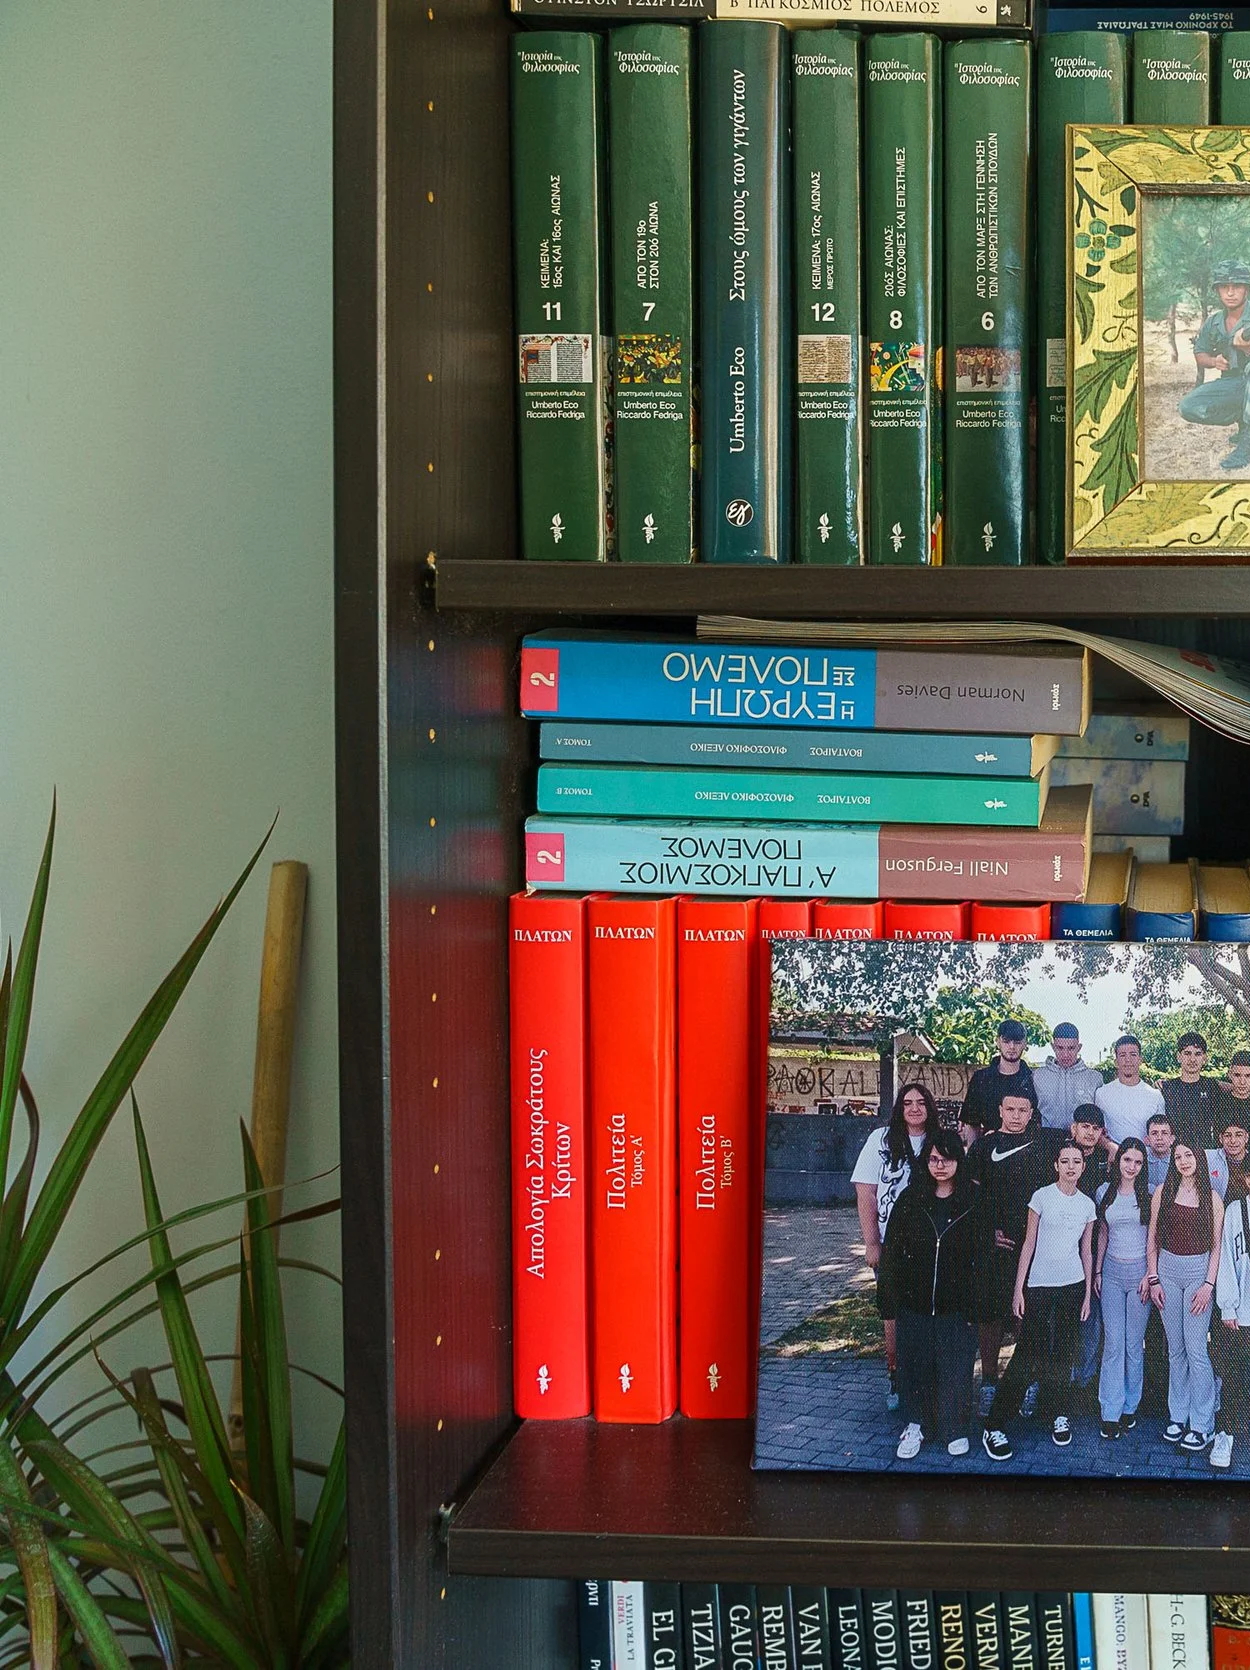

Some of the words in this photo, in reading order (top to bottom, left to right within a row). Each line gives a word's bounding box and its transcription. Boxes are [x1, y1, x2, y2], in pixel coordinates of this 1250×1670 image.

[860, 0, 940, 14] ΠΟΛΕΜΟΣ
[1149, 21, 1173, 29] ΜΙΑΣ
[522, 61, 580, 75] Φιλοσοφίας
[1147, 69, 1207, 83] Φιλοσοφίας
[959, 73, 1020, 87] Φιλοσοφίας
[728, 69, 750, 150] γιγάντων
[733, 153, 746, 185] των
[975, 140, 985, 190] ΓΕΝΝΗΣΗ
[988, 132, 998, 183] ΣΠΟΥΔΩΝ
[895, 147, 907, 208] ΕΠΙΣΤΗΜΕΣ
[550, 175, 560, 216] ΑΙΩΝΑΣ
[811, 172, 821, 212] ΑΙΩΝΑΣ
[976, 193, 986, 215] ΣΤΗ
[729, 189, 749, 245] ώμους
[896, 210, 906, 228] ΚΑΙ
[976, 217, 986, 248] ΜΑΡΞ
[988, 186, 999, 273] ΑΝΘΡΩΠΙΣΤΙΚΩΝ
[553, 244, 562, 263] ΚΑΙ
[636, 242, 646, 264] ΤΟΝ
[826, 237, 834, 263] ΠΡΩΤΟ
[540, 238, 550, 289] ΚΕΙΜΕΝΑ:
[811, 240, 822, 290] ΚΕΙΜΕΝΑ:
[896, 231, 907, 296] ΦΙΛΟΣΟΦΙΕΣ
[976, 251, 986, 273] ΤΟΝ
[636, 267, 646, 289] ΑΠΟ
[729, 250, 750, 301] Στους
[976, 276, 986, 299] ΑΠΟ
[988, 278, 999, 299] ΤΩΝ
[542, 302, 562, 321] 11
[642, 302, 656, 322] 7
[811, 302, 835, 322] 12
[889, 310, 903, 330] 8
[981, 311, 995, 331] 6
[730, 346, 745, 377] Eco
[616, 410, 651, 420] Riccardo
[653, 410, 683, 420] Fedriga
[623, 401, 657, 410] Umberto
[659, 402, 676, 410] Eco
[729, 381, 745, 453] Umberto
[662, 651, 829, 687] ΠΟΛΕΜΟ
[897, 683, 950, 700] Davies
[957, 687, 1025, 703] Norman
[690, 687, 836, 720] ΕΥΡΩΠΗ
[563, 739, 593, 747] ΤΟΜΟΣ
[690, 742, 725, 753] ΛΕΞΙΚΟ
[726, 744, 788, 755] ΦΙΛΟΣΟΦΙΚΟ
[809, 747, 863, 758] ΒΟΛΤΑΙΡΟΣ
[660, 837, 801, 860] ΠΟΛΕΜΟΣ
[619, 862, 801, 888] ΠΑΓΚΟΣΜΙΟΣ
[885, 856, 964, 876] Ferguson
[969, 860, 1009, 876] Niall
[514, 929, 573, 942] ΠΛΑΤΩΝ
[595, 926, 655, 939] ΠΛΑΤΩΝ
[684, 929, 746, 942] ΠΛΑΤΩΝ
[525, 1047, 549, 1169] Σωκράτους
[551, 1122, 577, 1199] Κρίτων
[606, 1113, 627, 1210] Πολιτεία
[630, 1149, 646, 1188] Τόμος
[695, 1114, 716, 1210] Πολιτεία
[525, 1175, 550, 1279] Απολογία
[626, 1594, 634, 1645] TRAVIATA
[652, 1609, 674, 1641] EL
[798, 1602, 822, 1656] VAN
[1171, 1633, 1187, 1669] BECK
